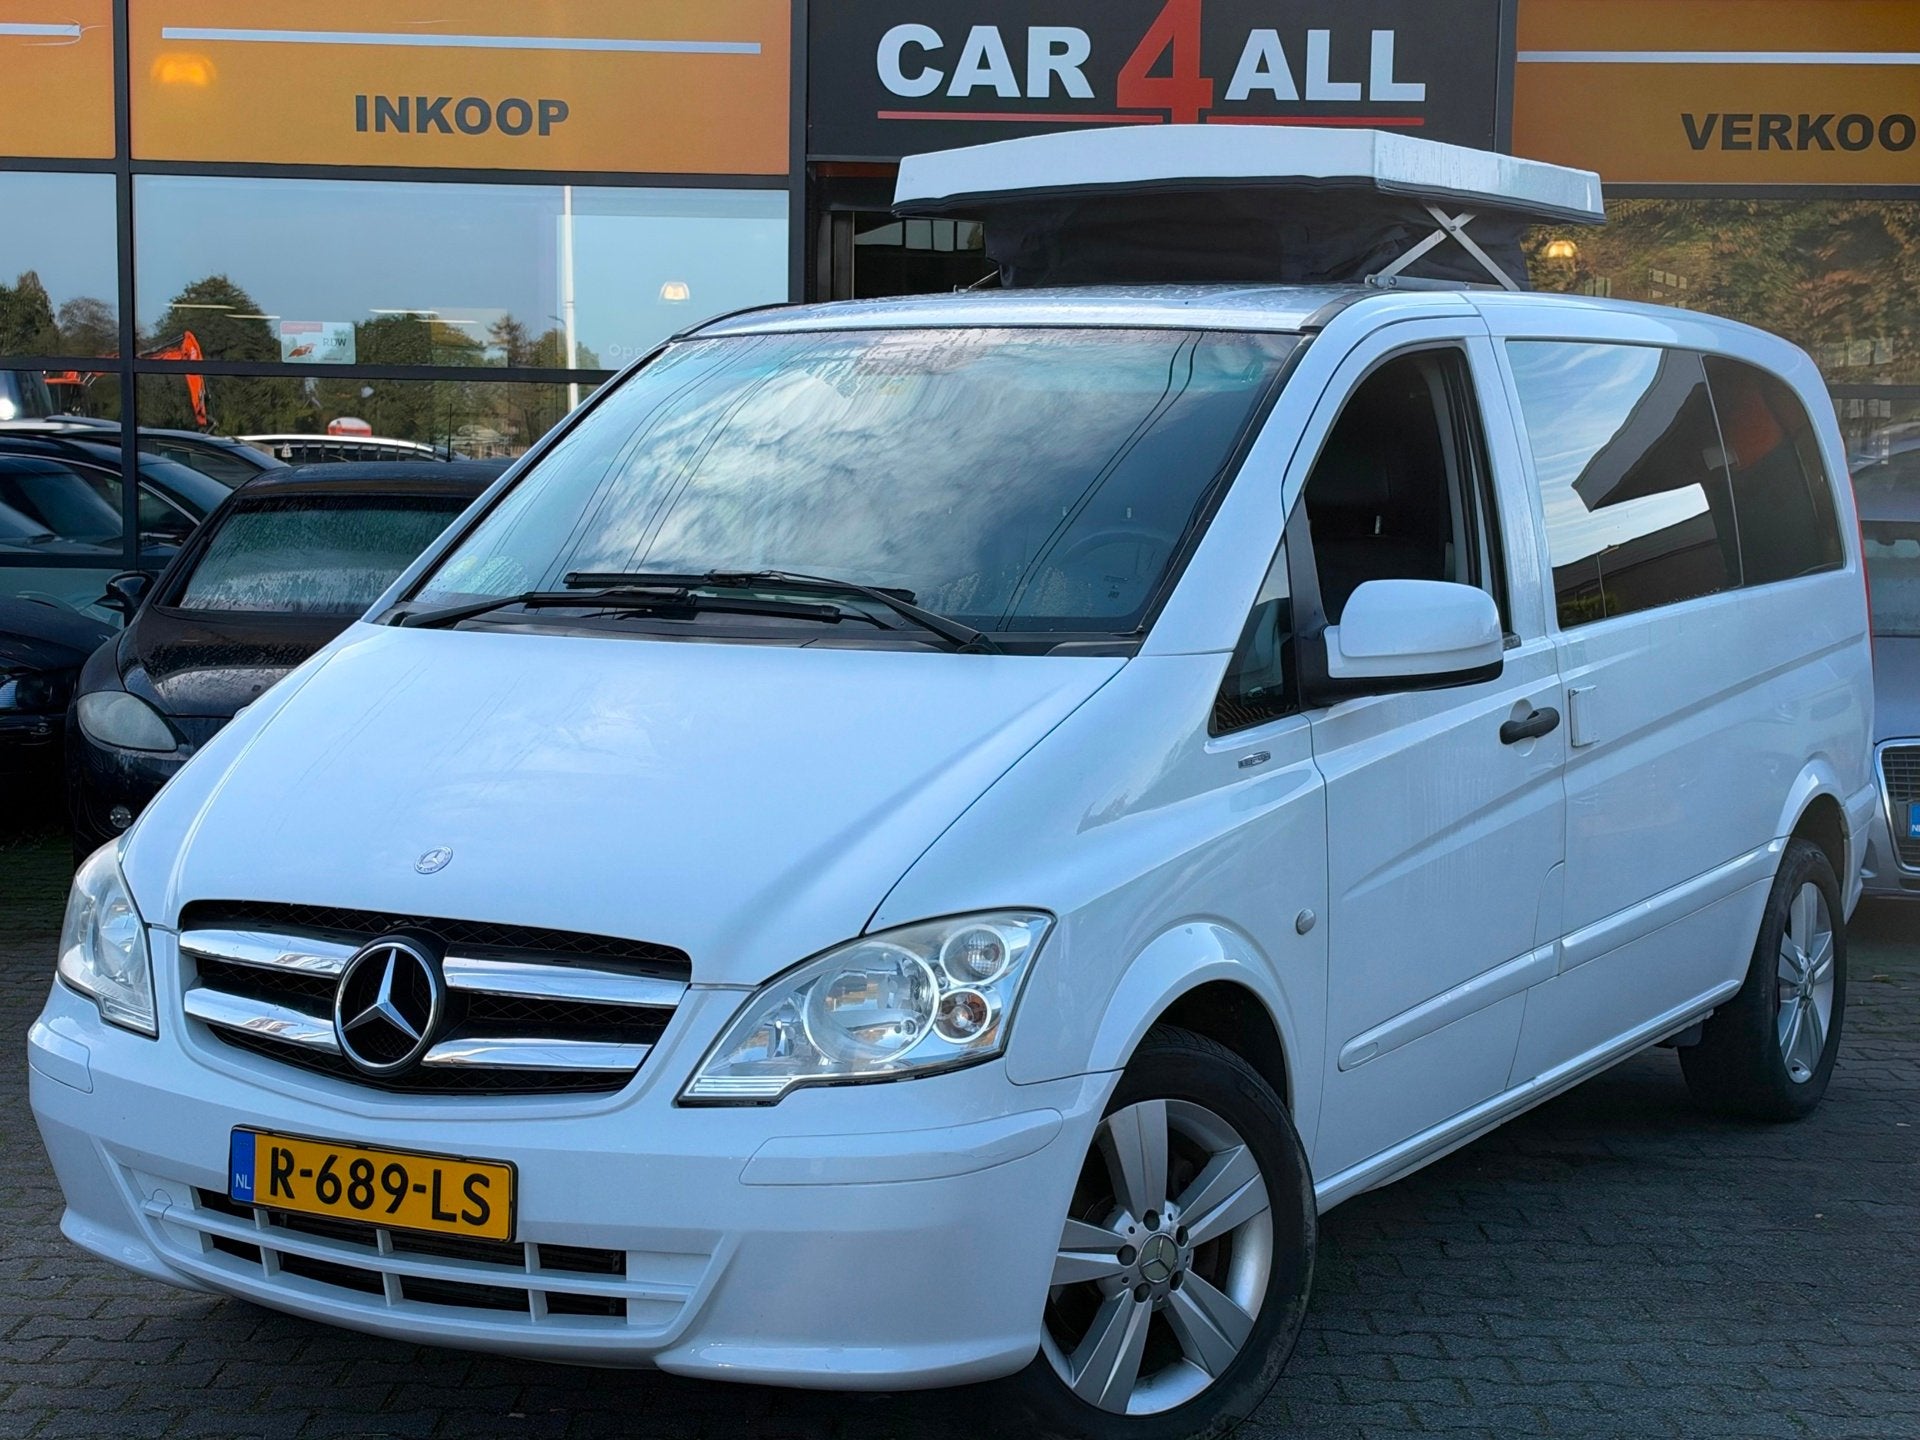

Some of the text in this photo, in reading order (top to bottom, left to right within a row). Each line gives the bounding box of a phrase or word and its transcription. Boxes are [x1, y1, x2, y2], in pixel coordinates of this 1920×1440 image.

[355, 95, 569, 136] INKOOP
[1681, 113, 1916, 152] VERKOO
[235, 1174, 251, 1190] NL
[270, 1147, 491, 1226] R-689-LS
